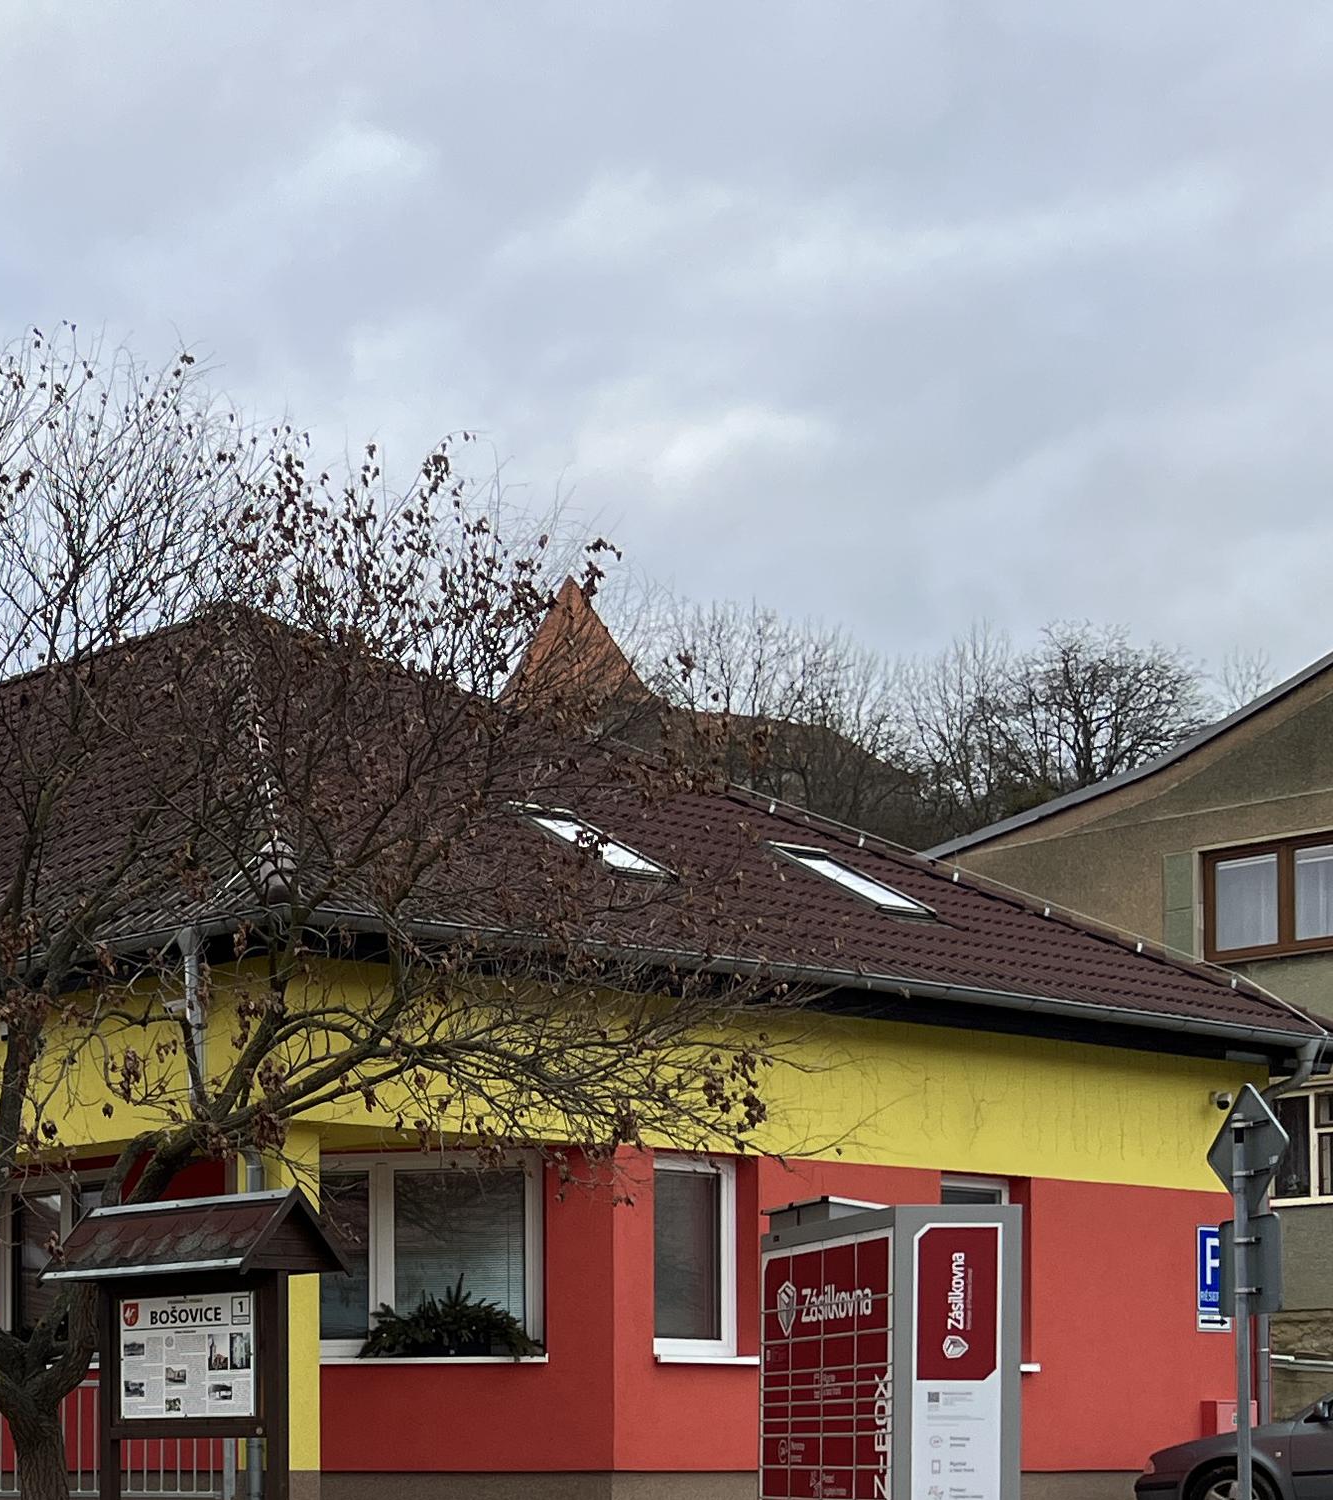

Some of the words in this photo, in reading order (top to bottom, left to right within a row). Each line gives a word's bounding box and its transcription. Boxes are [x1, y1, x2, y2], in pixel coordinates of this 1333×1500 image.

[237, 1301, 244, 1313] 1
[801, 1284, 872, 1323] Zásilkovna
[947, 1252, 965, 1330] Zásilkovna
[150, 1306, 222, 1325] BOŠOVICE
[874, 1373, 889, 1499] Z-BOX
